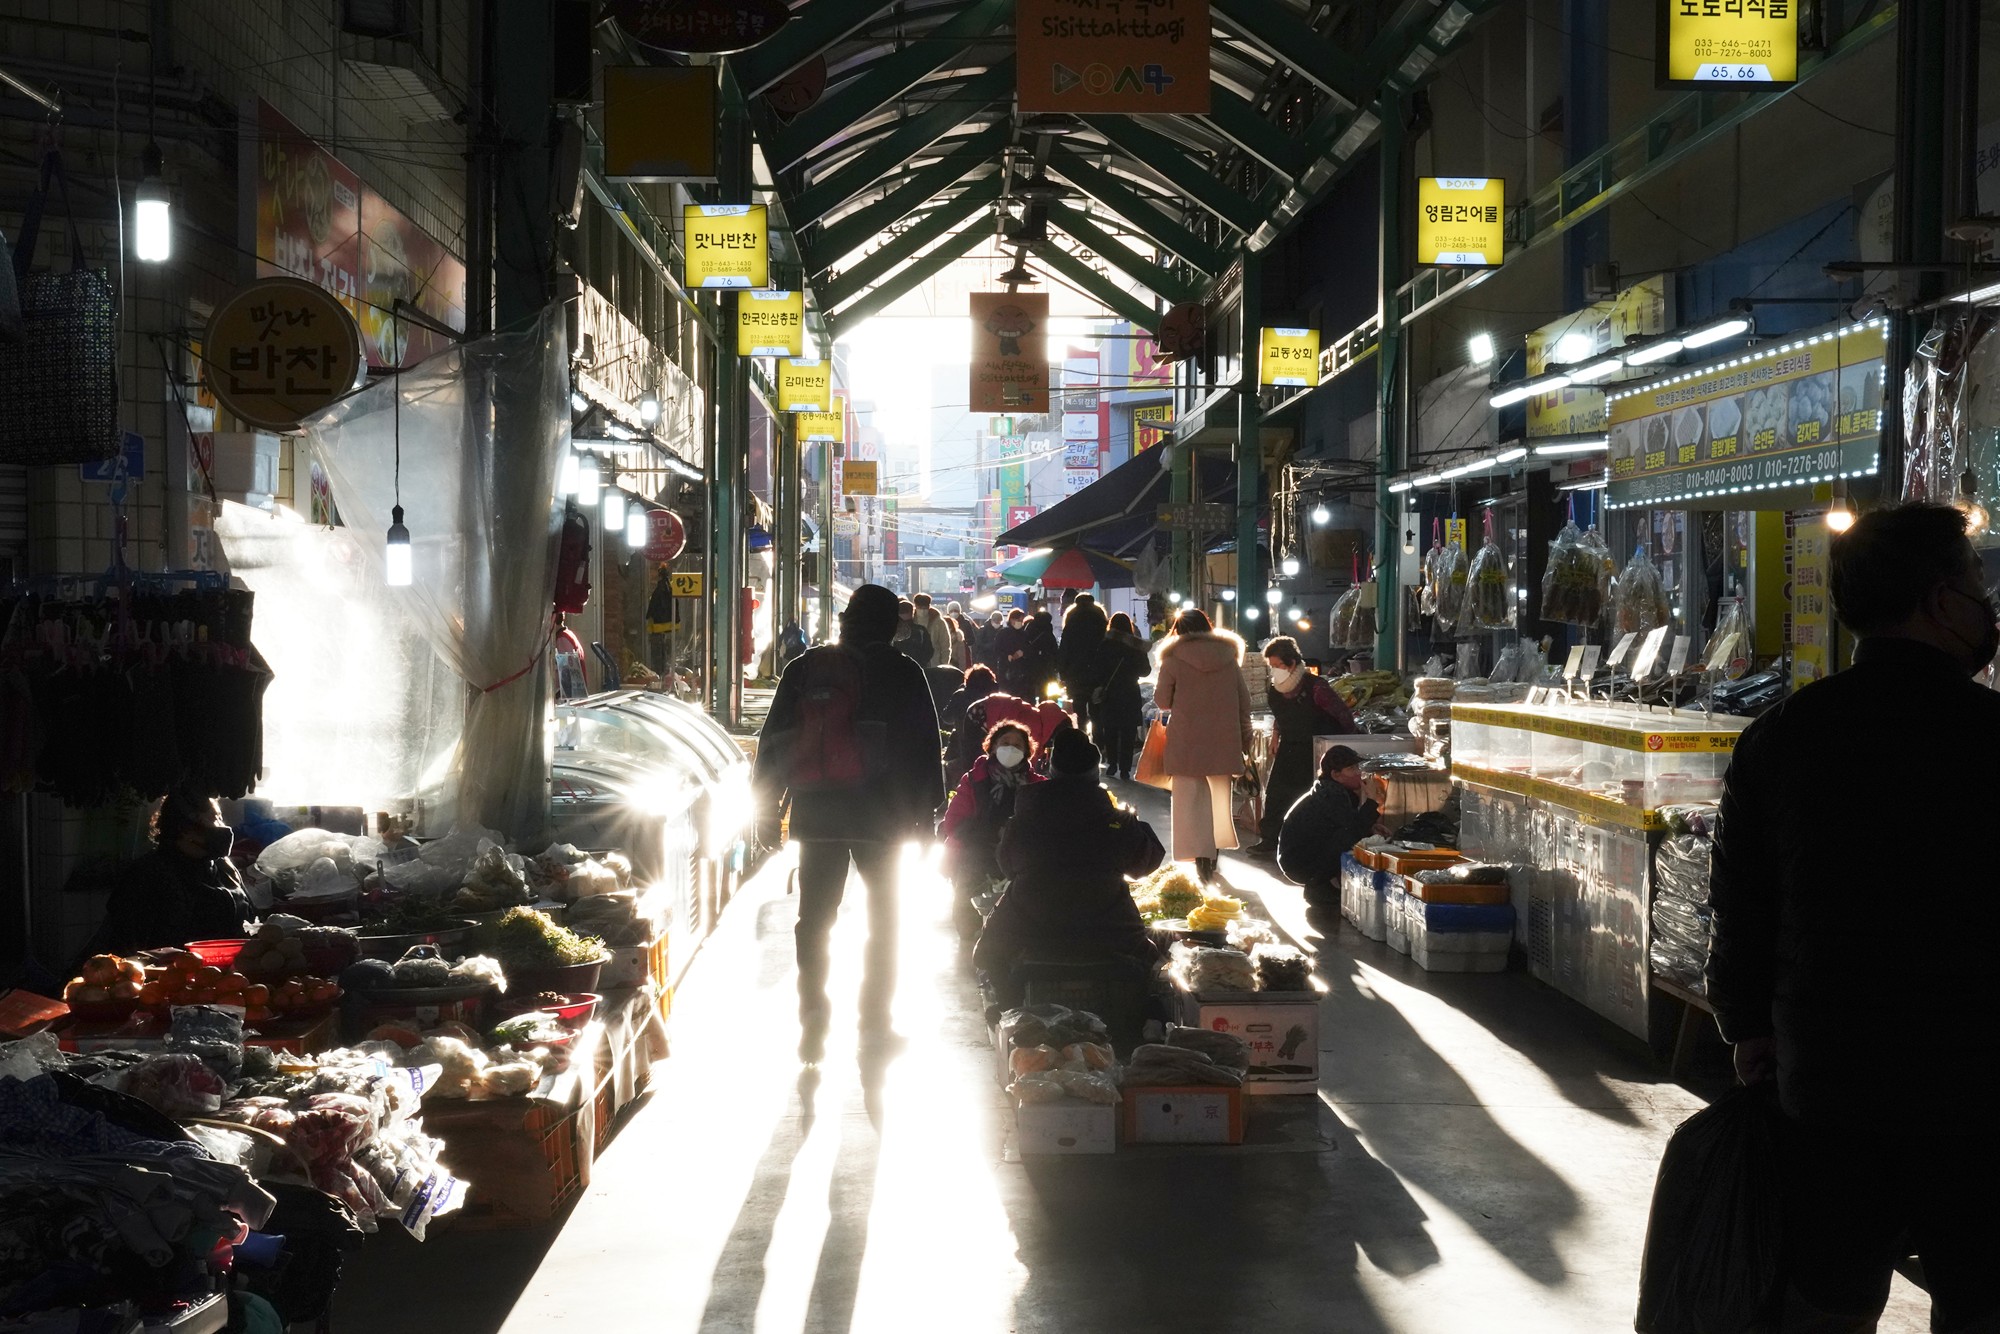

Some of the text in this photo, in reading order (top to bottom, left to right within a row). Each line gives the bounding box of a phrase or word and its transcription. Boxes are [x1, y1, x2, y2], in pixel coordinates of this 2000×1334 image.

[1042, 16, 1185, 44] Sisittakttagi
[1694, 38, 1772, 48] 033-646-0471
[1694, 48, 1772, 58] 010-7276-8003
[1737, 66, 1755, 78] 66
[1425, 205, 1497, 223] 영림건어물
[694, 232, 758, 250] 맛나반찬
[1455, 254, 1466, 262] 51
[249, 300, 317, 342] 맛나
[742, 312, 799, 326] 한국인삼총판
[1270, 347, 1312, 360] 교동상회
[229, 345, 338, 395] 반찬
[1775, 353, 1812, 376] 도토리식품
[785, 376, 825, 387] 감미반찬
[1134, 408, 1162, 421] 도마횟집
[1754, 429, 1775, 451] 손만두
[1796, 421, 1820, 443] 감자떡
[1678, 444, 1697, 464] 메밀묵
[1711, 437, 1737, 459] 올방개묵
[1645, 450, 1666, 470] 도토리묵
[1686, 464, 1753, 488] 010-8040-8003
[1765, 449, 1843, 477] 010-7276-8003
[676, 576, 699, 594] 반
[1204, 1105, 1220, 1119] 京
